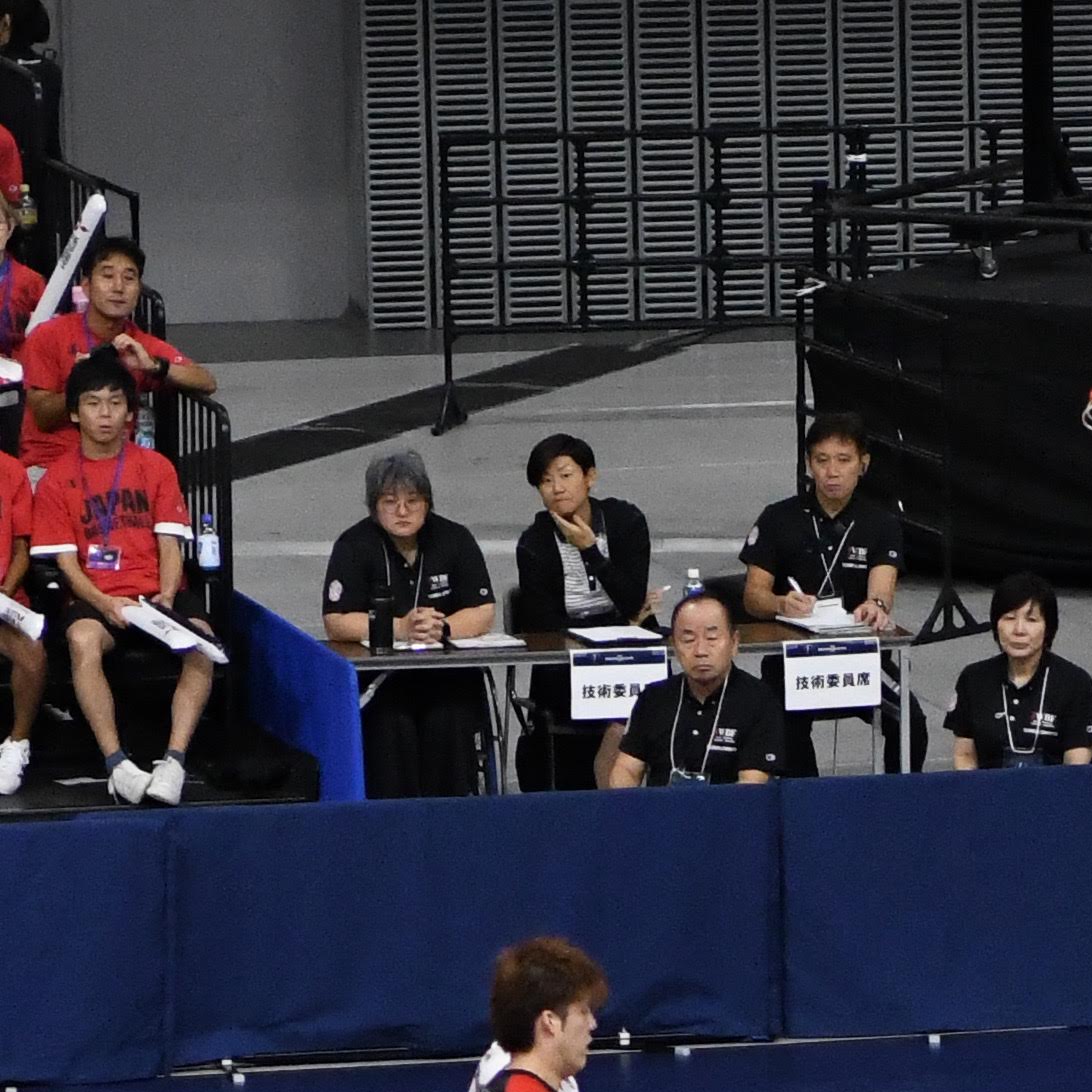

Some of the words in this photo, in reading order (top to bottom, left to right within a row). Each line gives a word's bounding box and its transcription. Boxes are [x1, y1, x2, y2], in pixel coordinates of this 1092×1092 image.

[796, 672, 870, 690] 技術委員席
[582, 683, 646, 699] 技術委員
